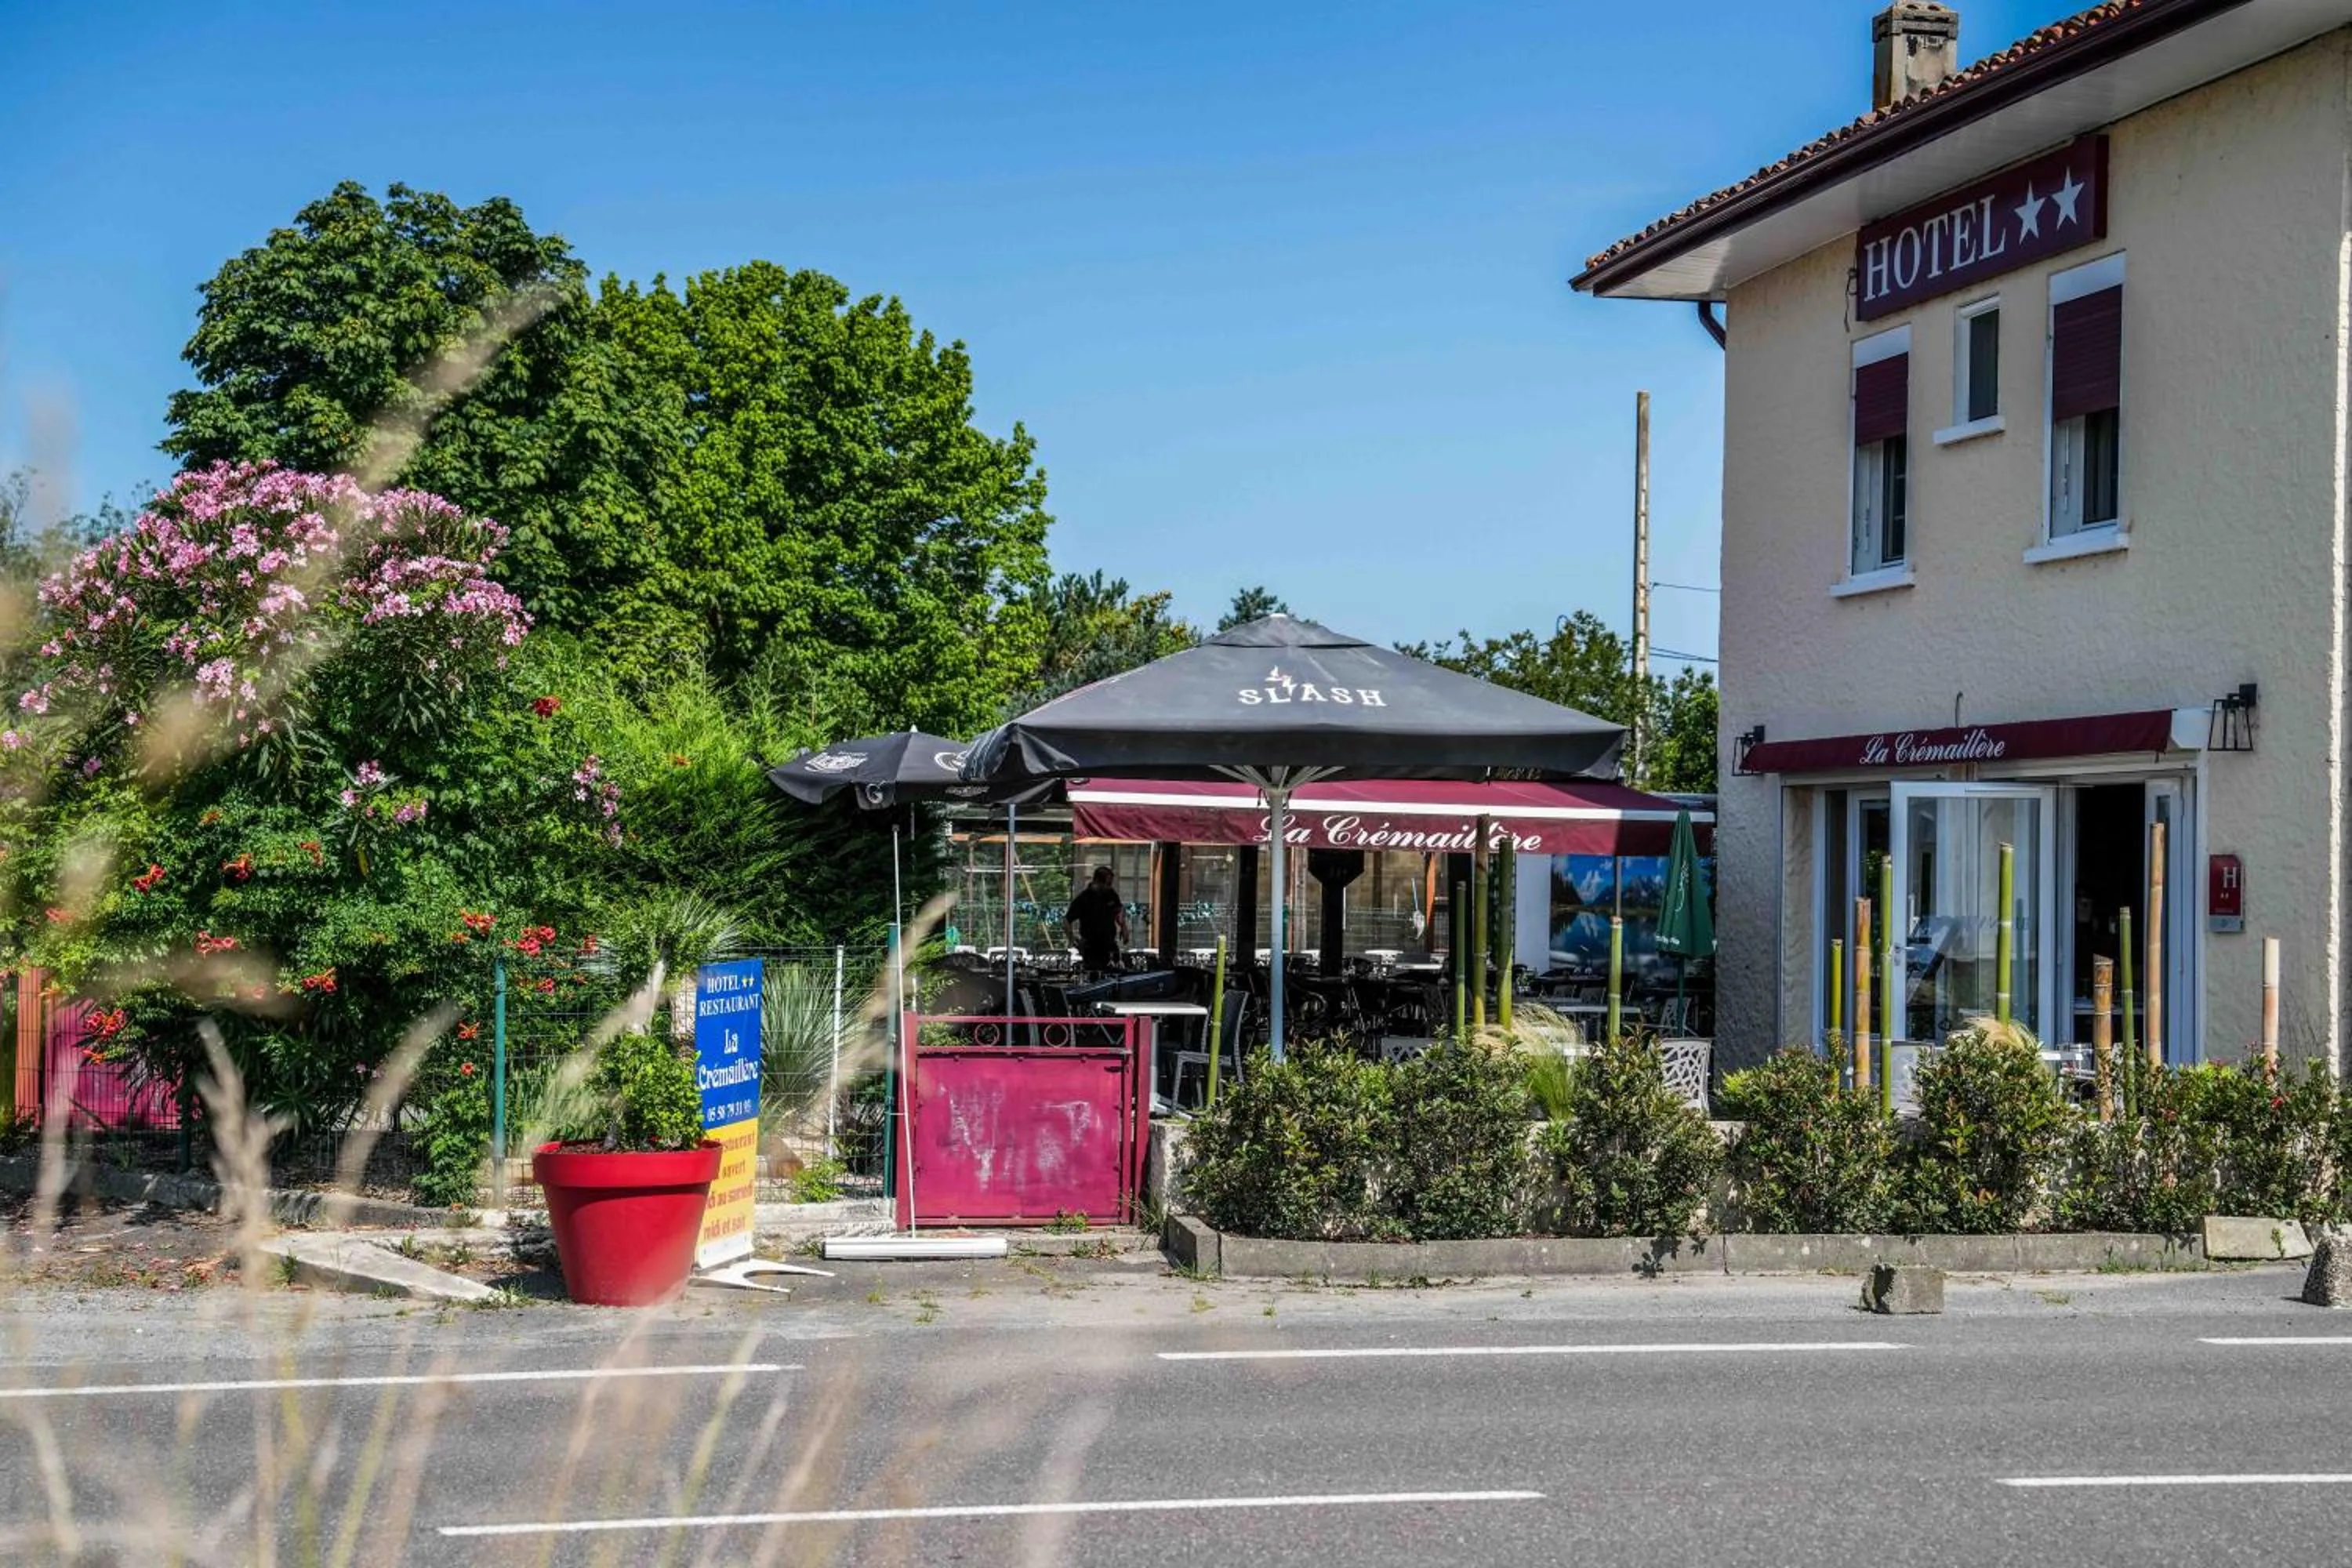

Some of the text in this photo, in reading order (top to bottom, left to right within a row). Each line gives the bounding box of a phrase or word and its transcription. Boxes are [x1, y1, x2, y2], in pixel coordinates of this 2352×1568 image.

[1864, 194, 2007, 302] HOTEL
[1237, 682, 1388, 706] SLASH
[1859, 728, 2006, 764] La Crémaillère
[1252, 814, 1312, 844] La
[2223, 866, 2237, 888] H
[707, 975, 741, 994] HOTEL
[699, 993, 760, 1017] RESTAURANT
[724, 1028, 739, 1054] La
[699, 1056, 758, 1091] Crémaillère
[714, 1130, 755, 1150] staurant
